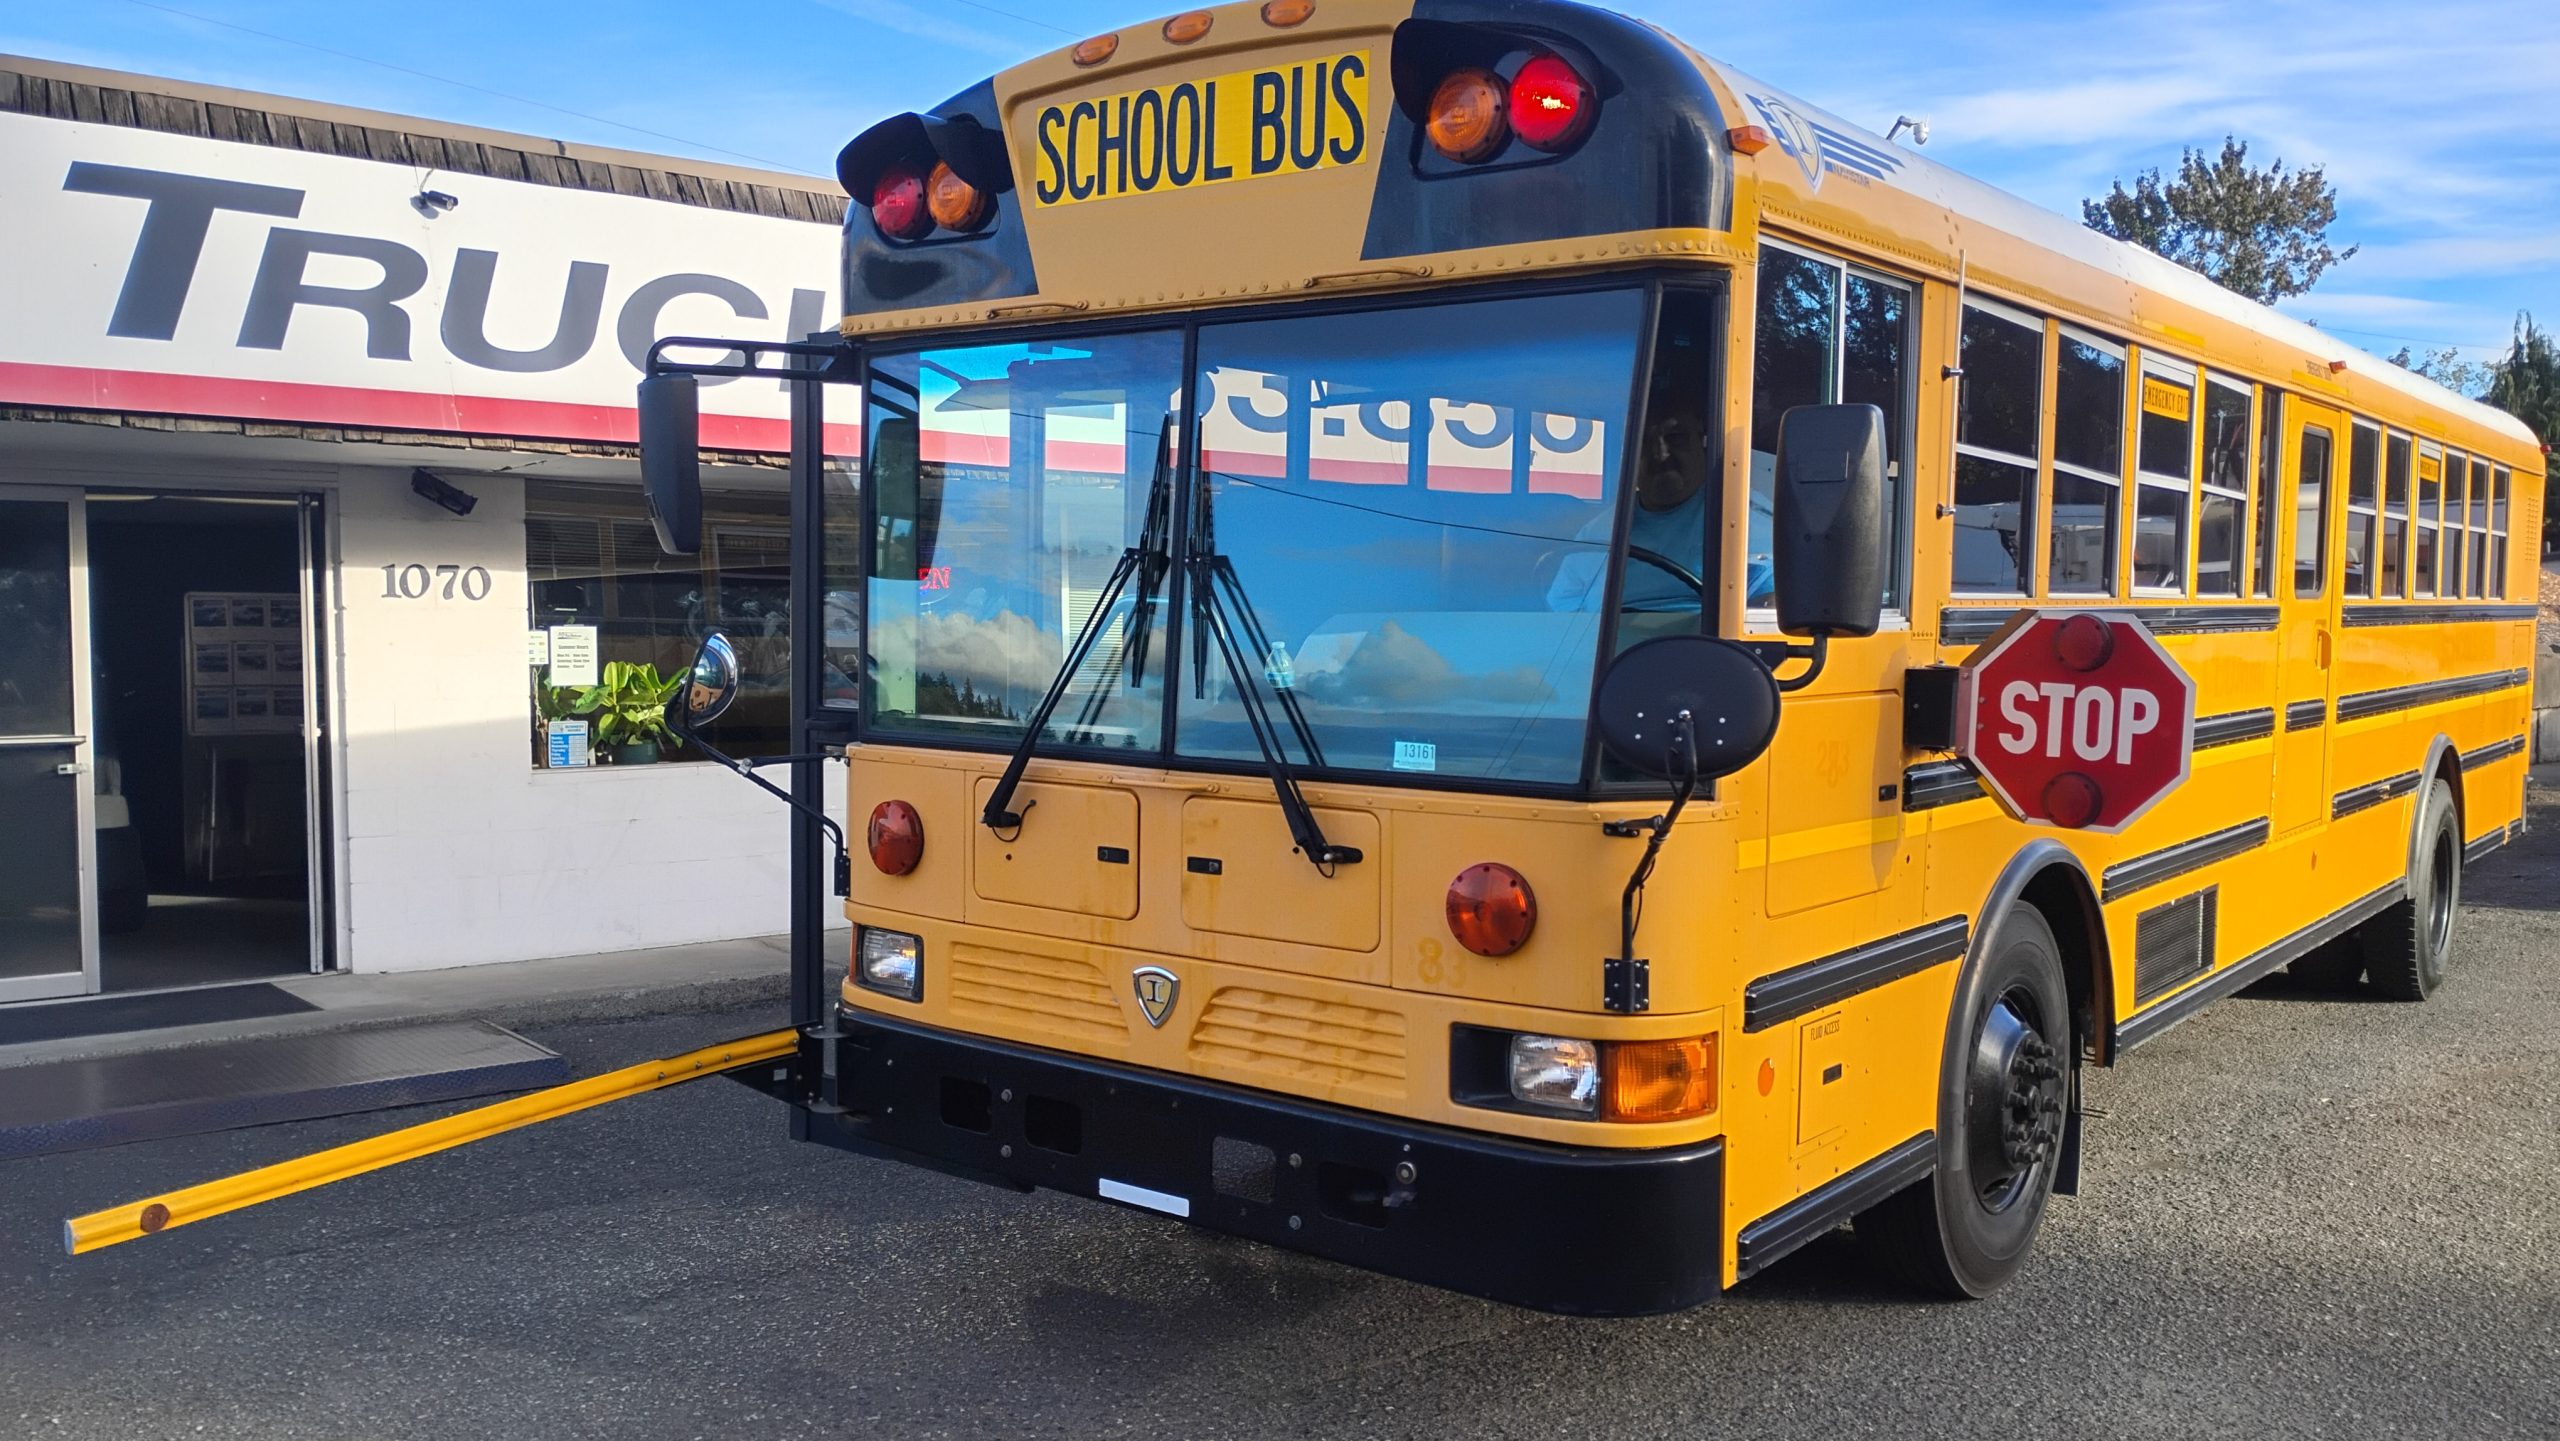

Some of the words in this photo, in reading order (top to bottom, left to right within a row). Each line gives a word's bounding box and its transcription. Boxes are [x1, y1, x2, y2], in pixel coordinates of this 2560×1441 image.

[1036, 82, 1232, 205] SCHOOL
[1251, 55, 1366, 177] BUS
[381, 563, 492, 601] 1070
[1998, 680, 2160, 765] STOP
